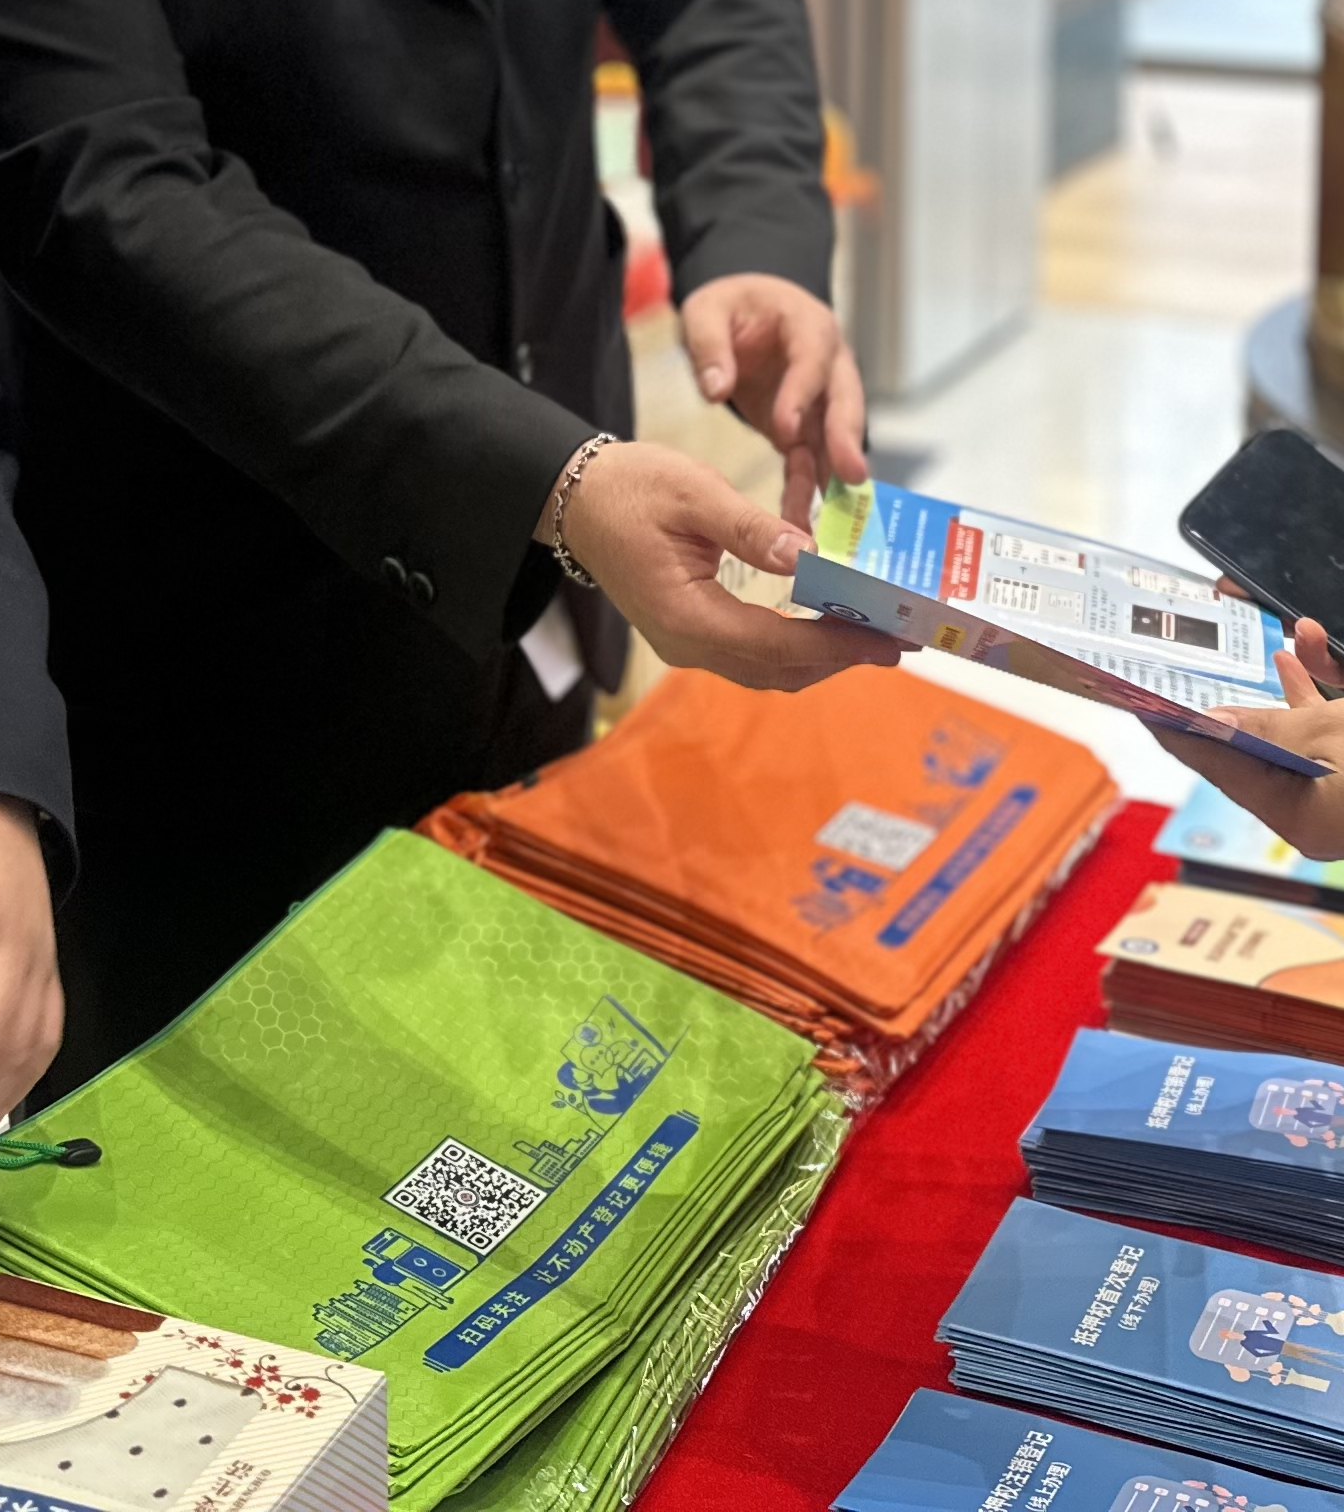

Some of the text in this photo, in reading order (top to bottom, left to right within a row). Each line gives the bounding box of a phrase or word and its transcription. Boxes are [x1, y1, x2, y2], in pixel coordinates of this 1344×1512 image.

[457, 1142, 673, 1346] 扫码关注 让不动产登记更便捷
[1070, 1245, 1145, 1347] 抵押权首次登记
[1117, 1276, 1160, 1330] (线下办理)
[977, 1430, 1054, 1512] 押权注销登记
